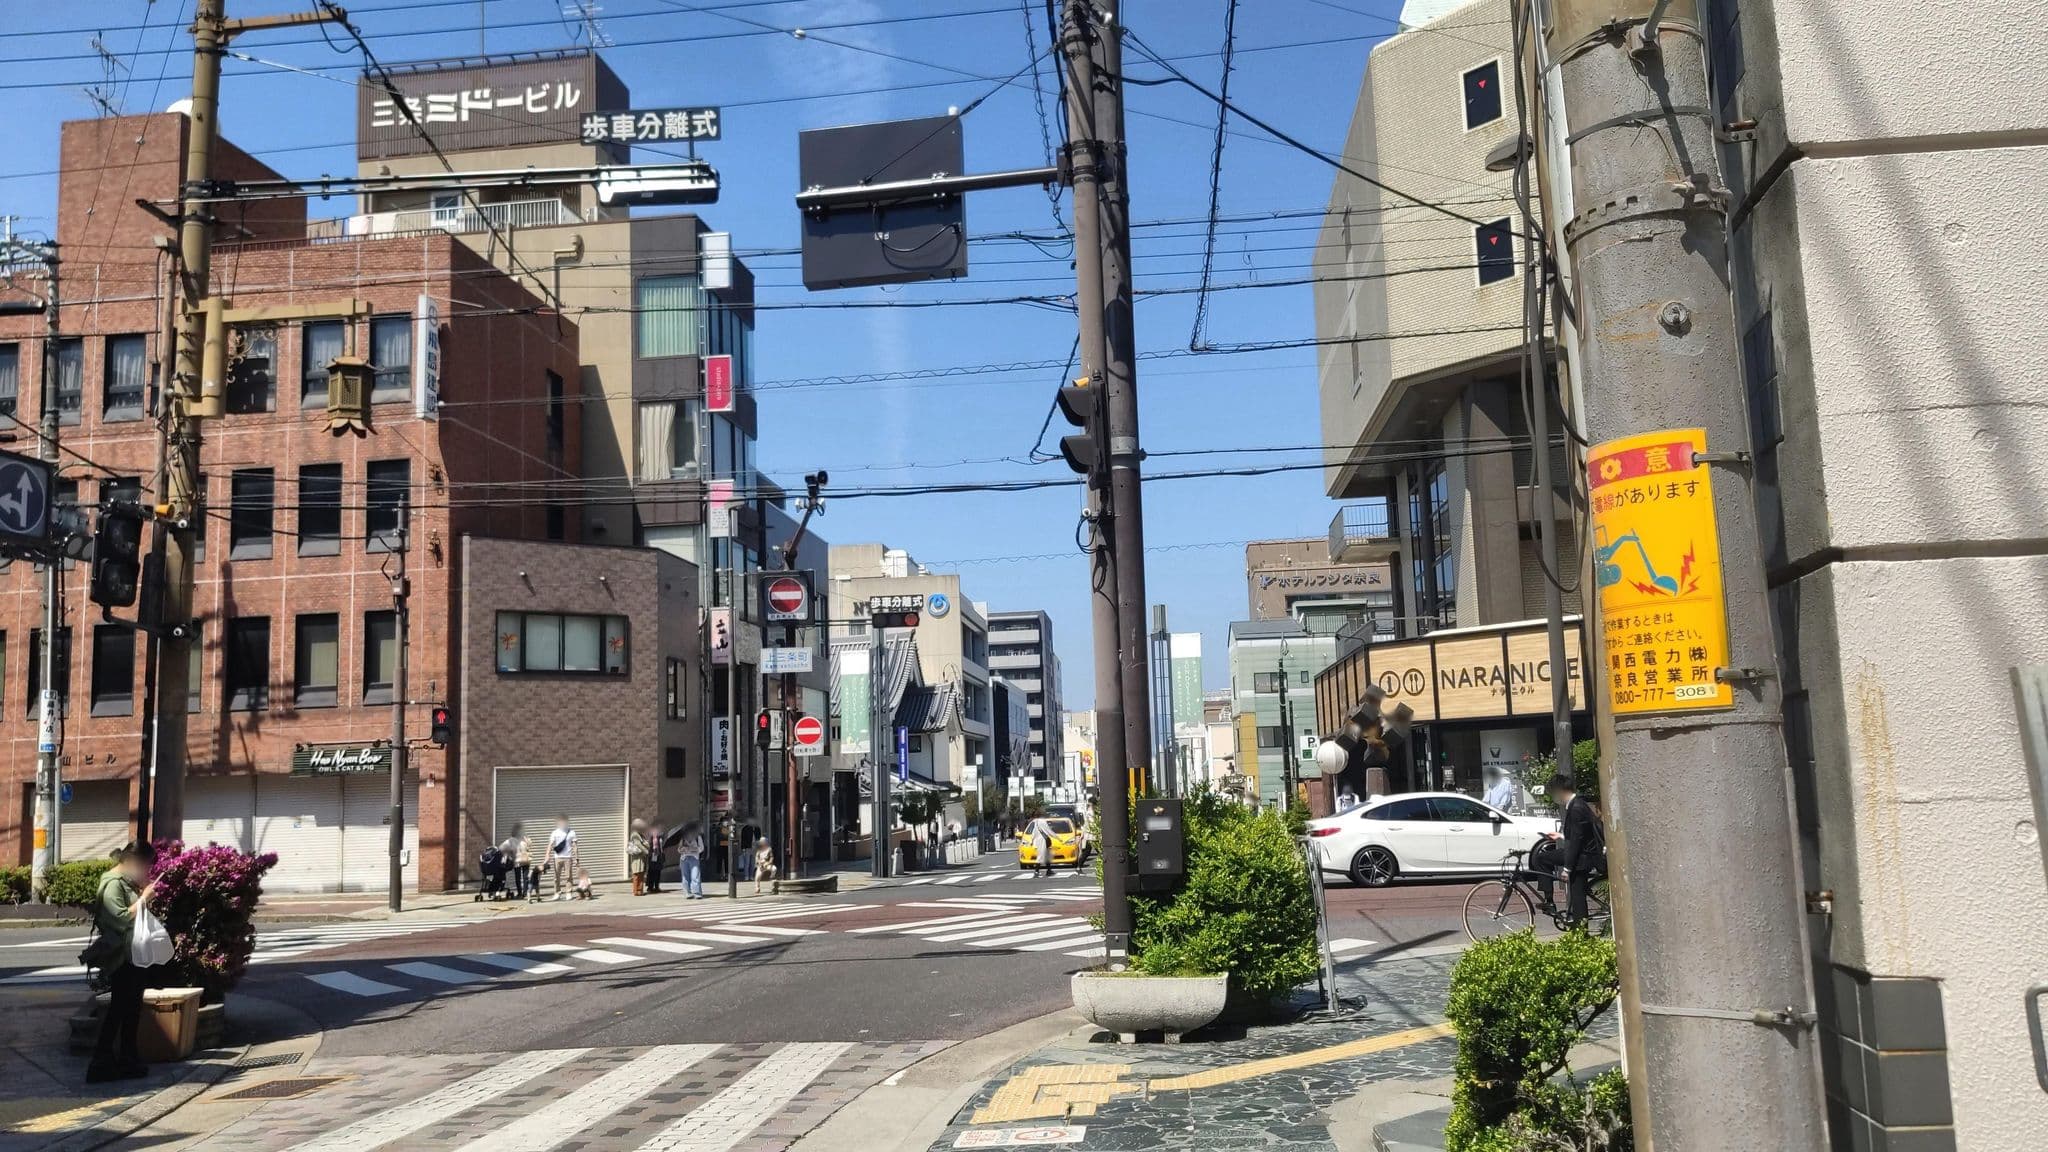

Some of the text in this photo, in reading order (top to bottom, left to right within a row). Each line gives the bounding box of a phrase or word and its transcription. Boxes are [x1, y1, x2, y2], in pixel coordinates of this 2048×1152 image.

[372, 82, 581, 127] 三条ミドービル
[582, 111, 718, 143] 歩車分離式
[1279, 573, 1382, 588] ホテルフジタ奈良
[871, 596, 923, 609] 歩車分離式
[1440, 657, 1581, 690] NARANICE
[1613, 665, 1709, 689] 奈良営業所
[1307, 736, 1316, 748] P
